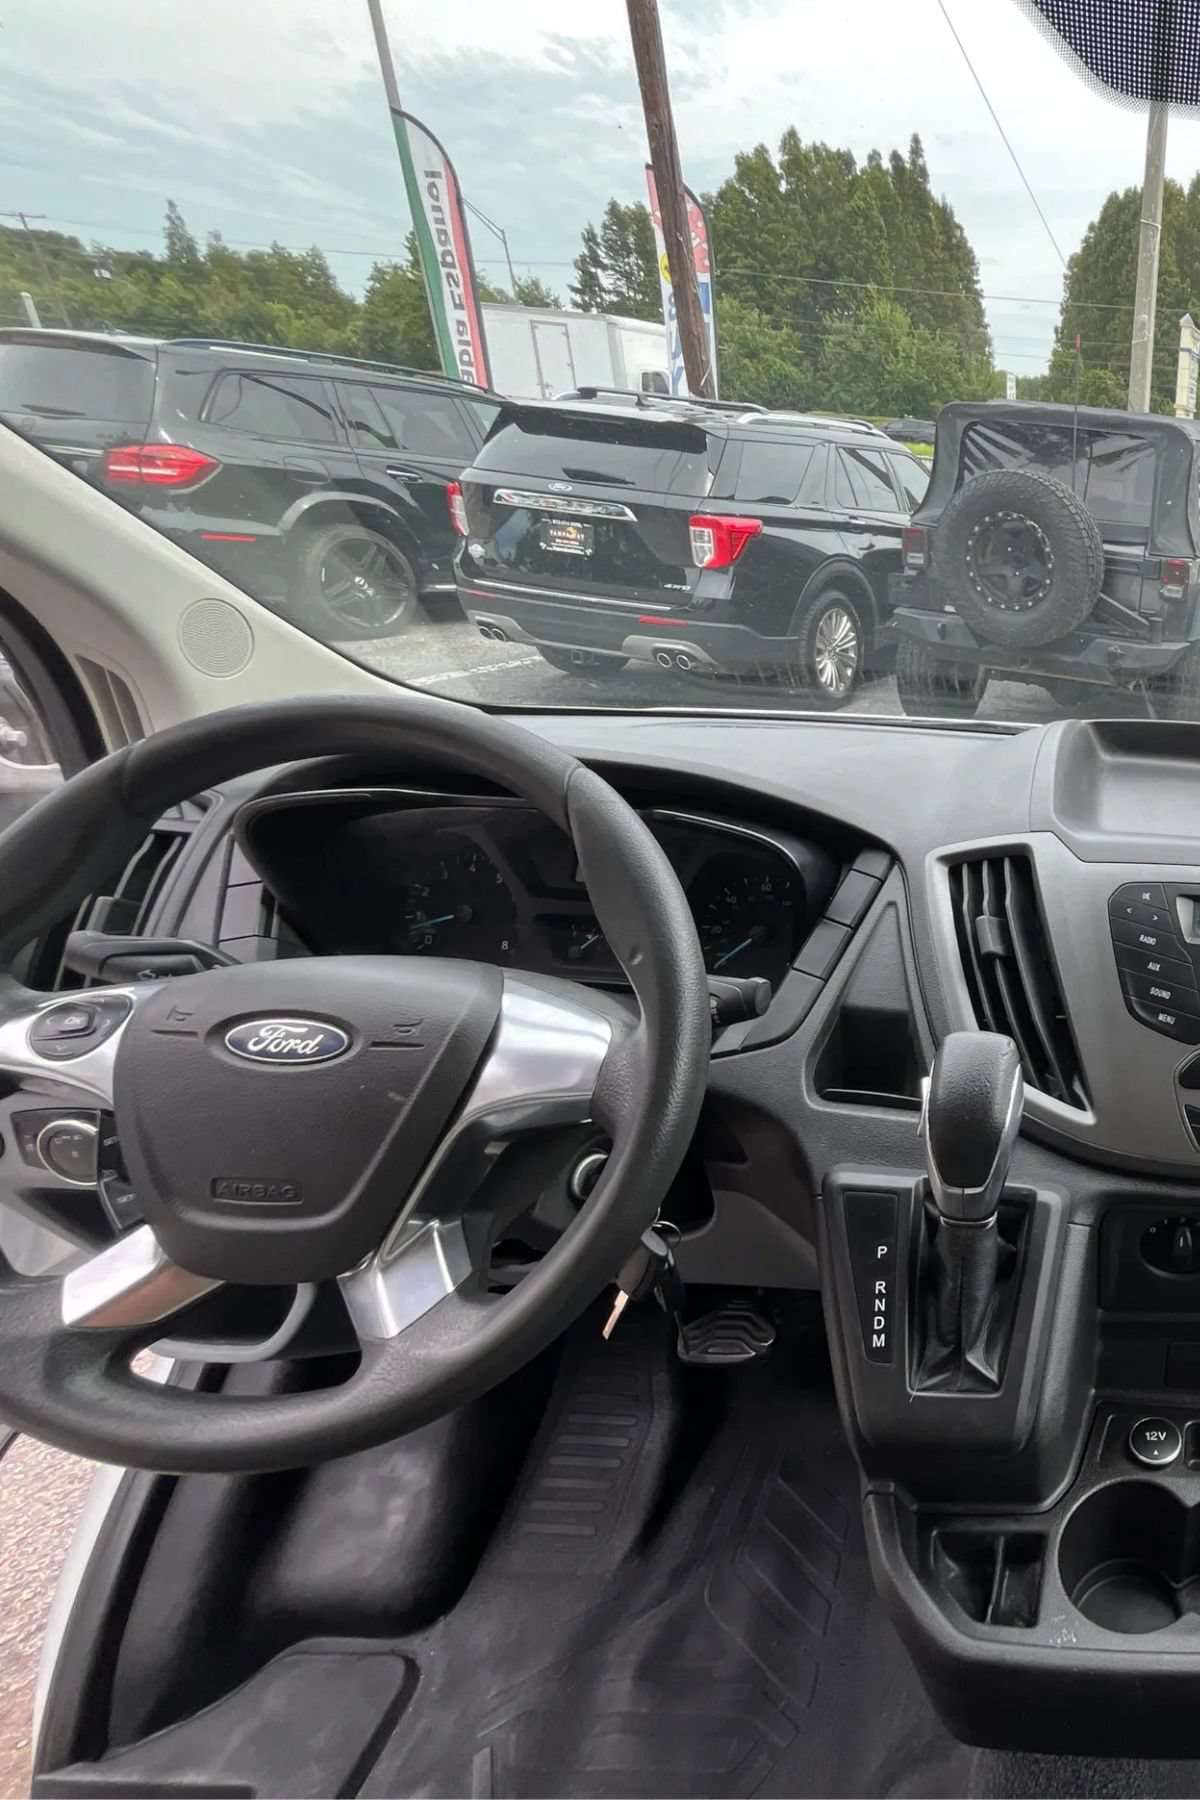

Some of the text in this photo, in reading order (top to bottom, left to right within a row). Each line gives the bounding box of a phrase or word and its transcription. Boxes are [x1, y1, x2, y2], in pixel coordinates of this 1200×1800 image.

[1139, 934, 1157, 945] RADIO
[1147, 961, 1161, 972] AUX
[1149, 987, 1171, 1000] SOUND
[1158, 1012, 1176, 1025] MENU
[247, 1024, 324, 1055] Ford
[219, 1182, 297, 1199] AIRBAG
[877, 1246, 888, 1259] P
[875, 1281, 886, 1294] R
[875, 1298, 885, 1312] N
[874, 1316, 885, 1329] D
[872, 1333, 885, 1347] M
[1145, 1431, 1167, 1440] 12V
